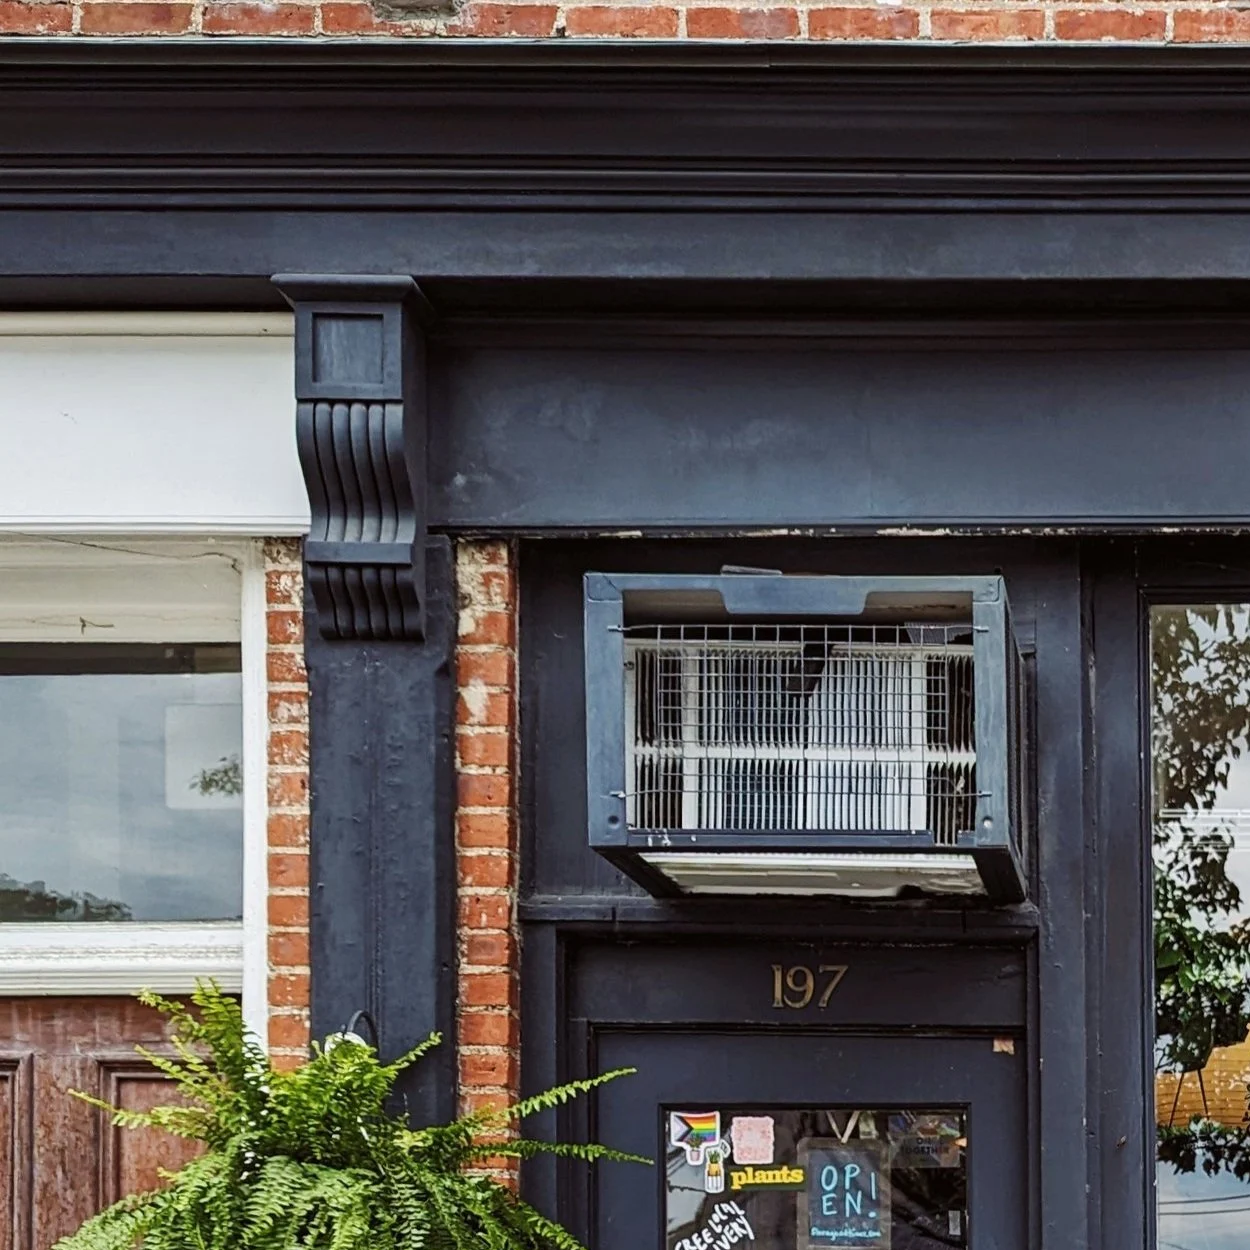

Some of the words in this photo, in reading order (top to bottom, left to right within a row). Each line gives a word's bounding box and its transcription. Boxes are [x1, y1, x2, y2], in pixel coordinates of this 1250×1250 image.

[771, 965, 849, 1009] 197
[730, 1165, 804, 1190] plants
[708, 1200, 745, 1233] LOCAL
